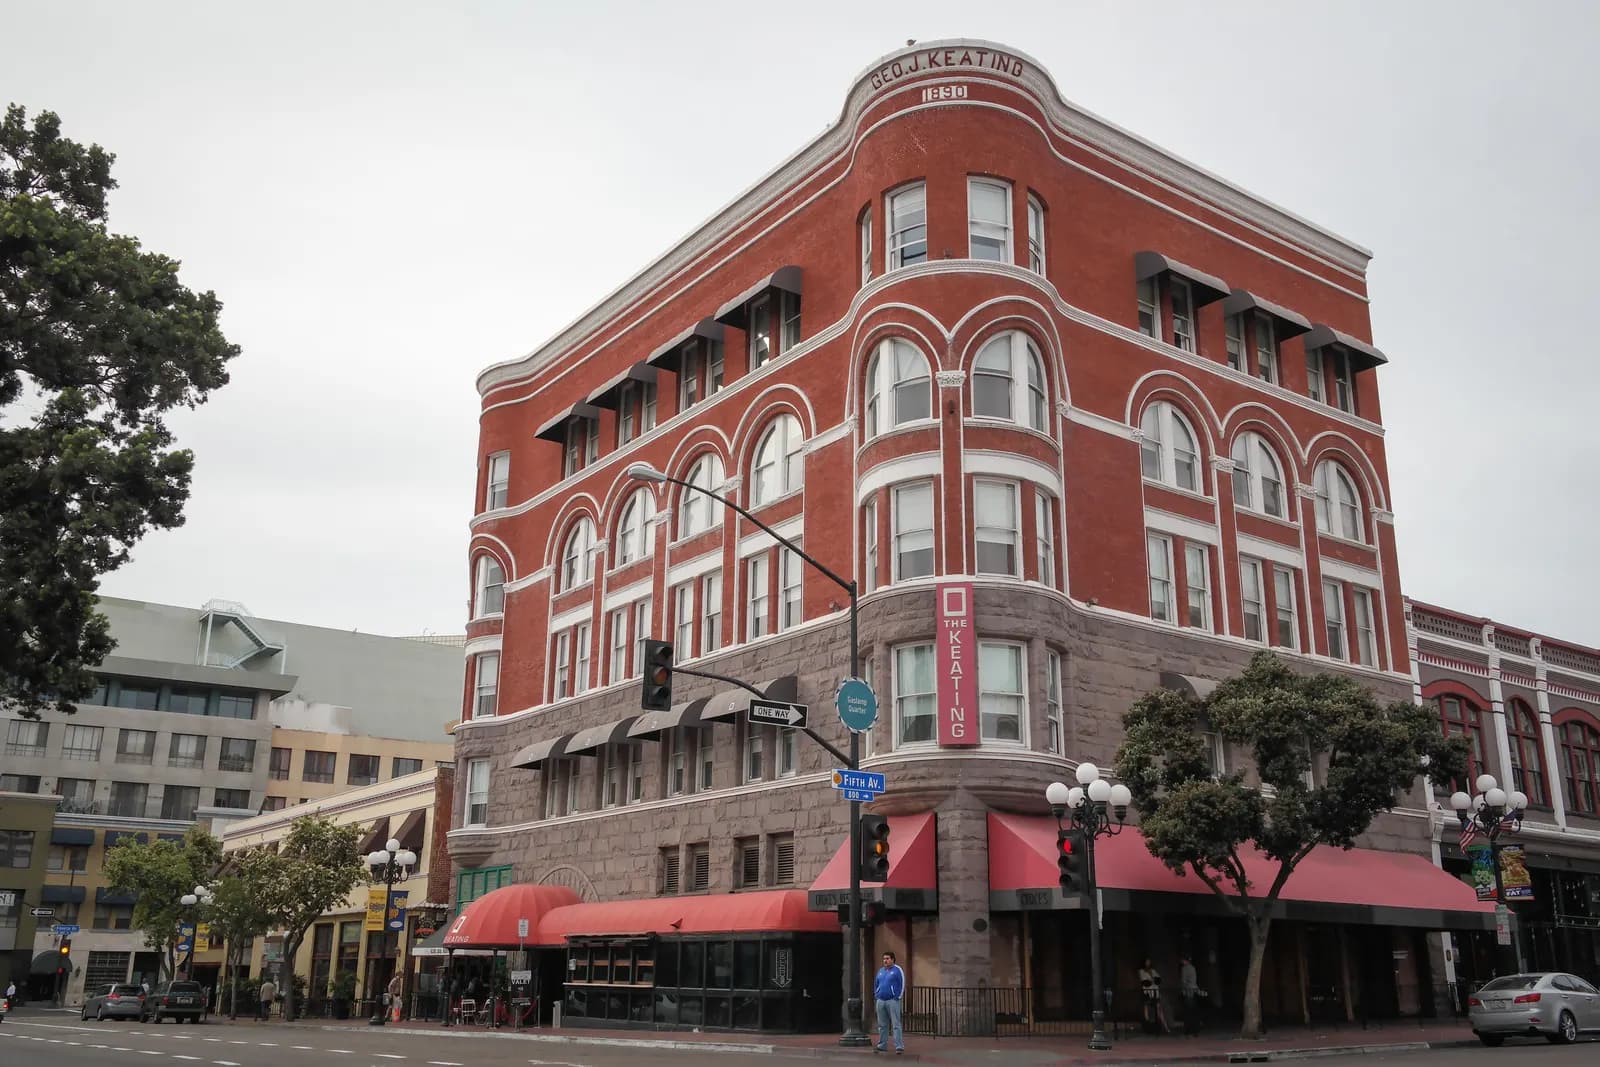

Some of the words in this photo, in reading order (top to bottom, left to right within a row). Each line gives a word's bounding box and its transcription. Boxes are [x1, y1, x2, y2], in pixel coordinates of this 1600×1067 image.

[923, 86, 966, 102] 1890
[943, 619, 967, 628] THE
[949, 630, 965, 738] KEATING
[757, 707, 773, 717] ONE
[775, 709, 790, 719] WAY
[844, 774, 865, 788] FIFTH
[847, 790, 860, 799] 800
